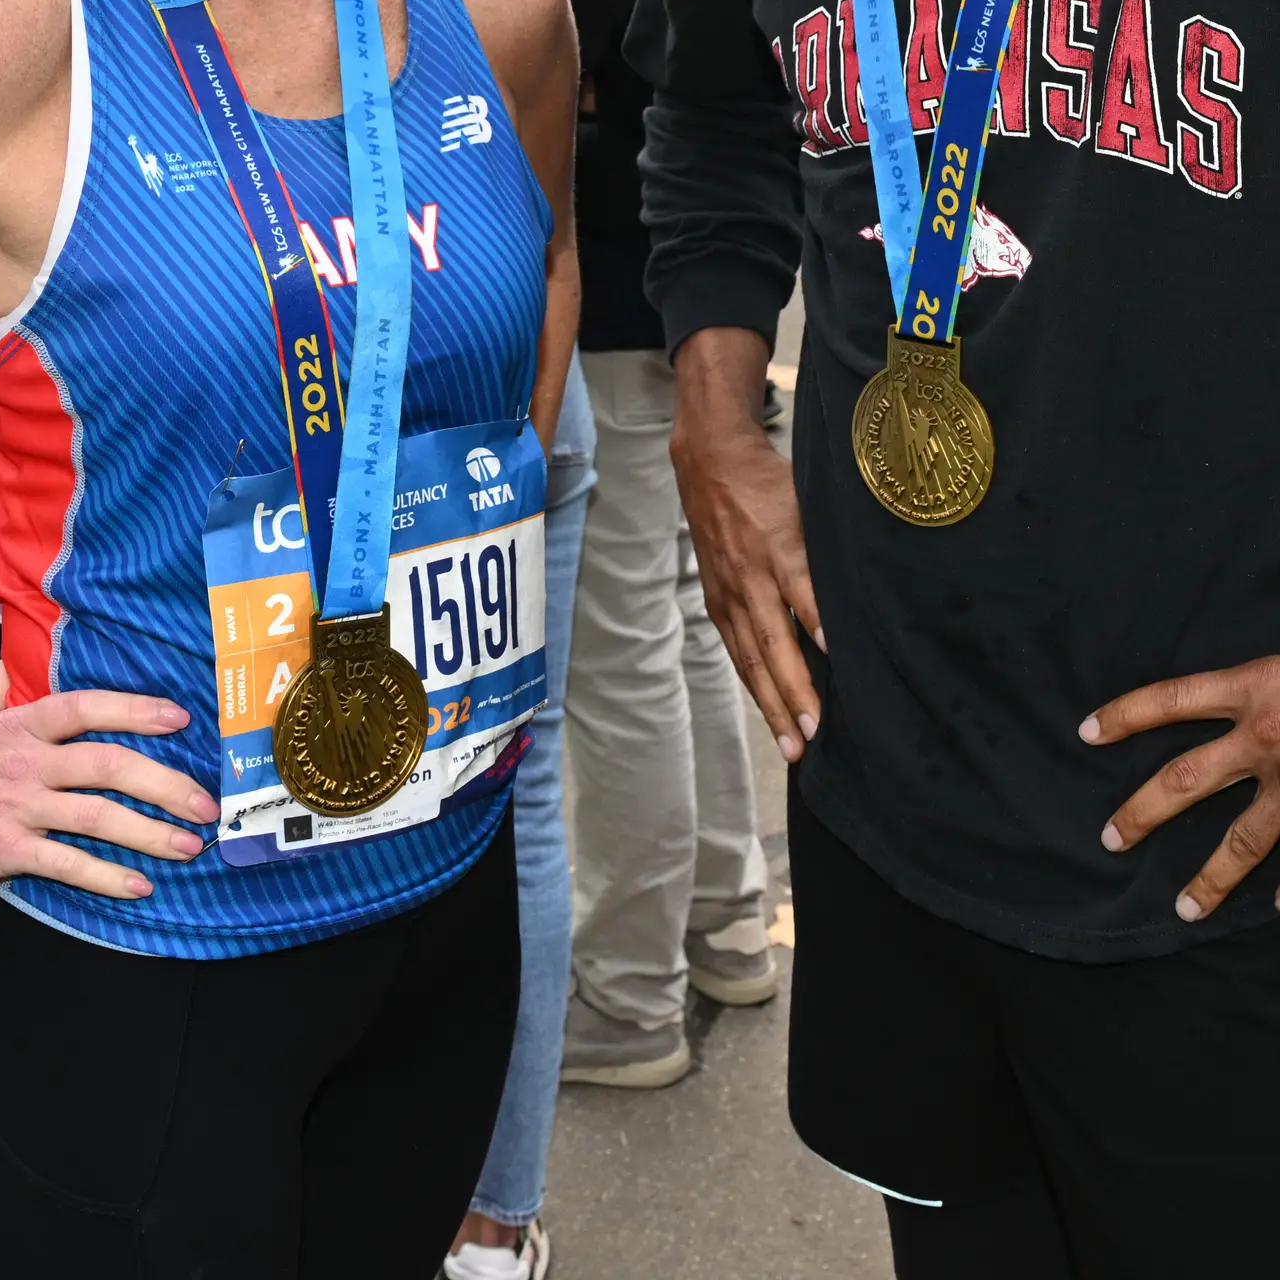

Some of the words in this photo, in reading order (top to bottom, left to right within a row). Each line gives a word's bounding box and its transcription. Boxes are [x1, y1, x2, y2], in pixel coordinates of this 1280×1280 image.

[971, 29, 988, 54] tcs
[196, 44, 234, 118] MARATHON
[229, 122, 248, 151] CITY
[876, 75, 891, 120] THE
[886, 132, 911, 214] BRONX
[165, 153, 182, 162] tcs
[169, 164, 188, 172] NEW
[190, 160, 214, 169] YORK
[244, 153, 263, 192] YORK
[362, 90, 389, 236] MANHATTAN
[175, 185, 195, 193] 2022
[259, 192, 279, 224] NEW
[932, 143, 969, 241] 2022
[272, 227, 288, 252] tcs
[900, 349, 948, 370] 2022
[294, 334, 331, 436] 2022
[915, 379, 945, 402] tcs
[868, 396, 905, 496] MARATHON
[948, 406, 973, 448] NEW
[350, 510, 372, 598] BRONX
[364, 318, 392, 475] MANHATTAN
[392, 483, 448, 510] ULTANCY
[469, 483, 514, 511] TATA
[253, 502, 306, 553] tc
[225, 605, 237, 644] WAVE
[265, 593, 296, 636] 2
[409, 539, 519, 680] 15191
[327, 629, 377, 648] 2022
[237, 664, 248, 715] CORRAL
[265, 661, 293, 705] A
[345, 660, 375, 680] tcs
[225, 668, 235, 720] ORANGE
[380, 674, 408, 711] NEW
[427, 696, 471, 736] 022
[245, 756, 262, 768] tcs
[293, 693, 337, 792] MARATHON
[319, 830, 339, 838] Poncho
[356, 823, 381, 832] Pre-Race
[383, 820, 393, 828] Bag
[394, 816, 411, 824] Check
